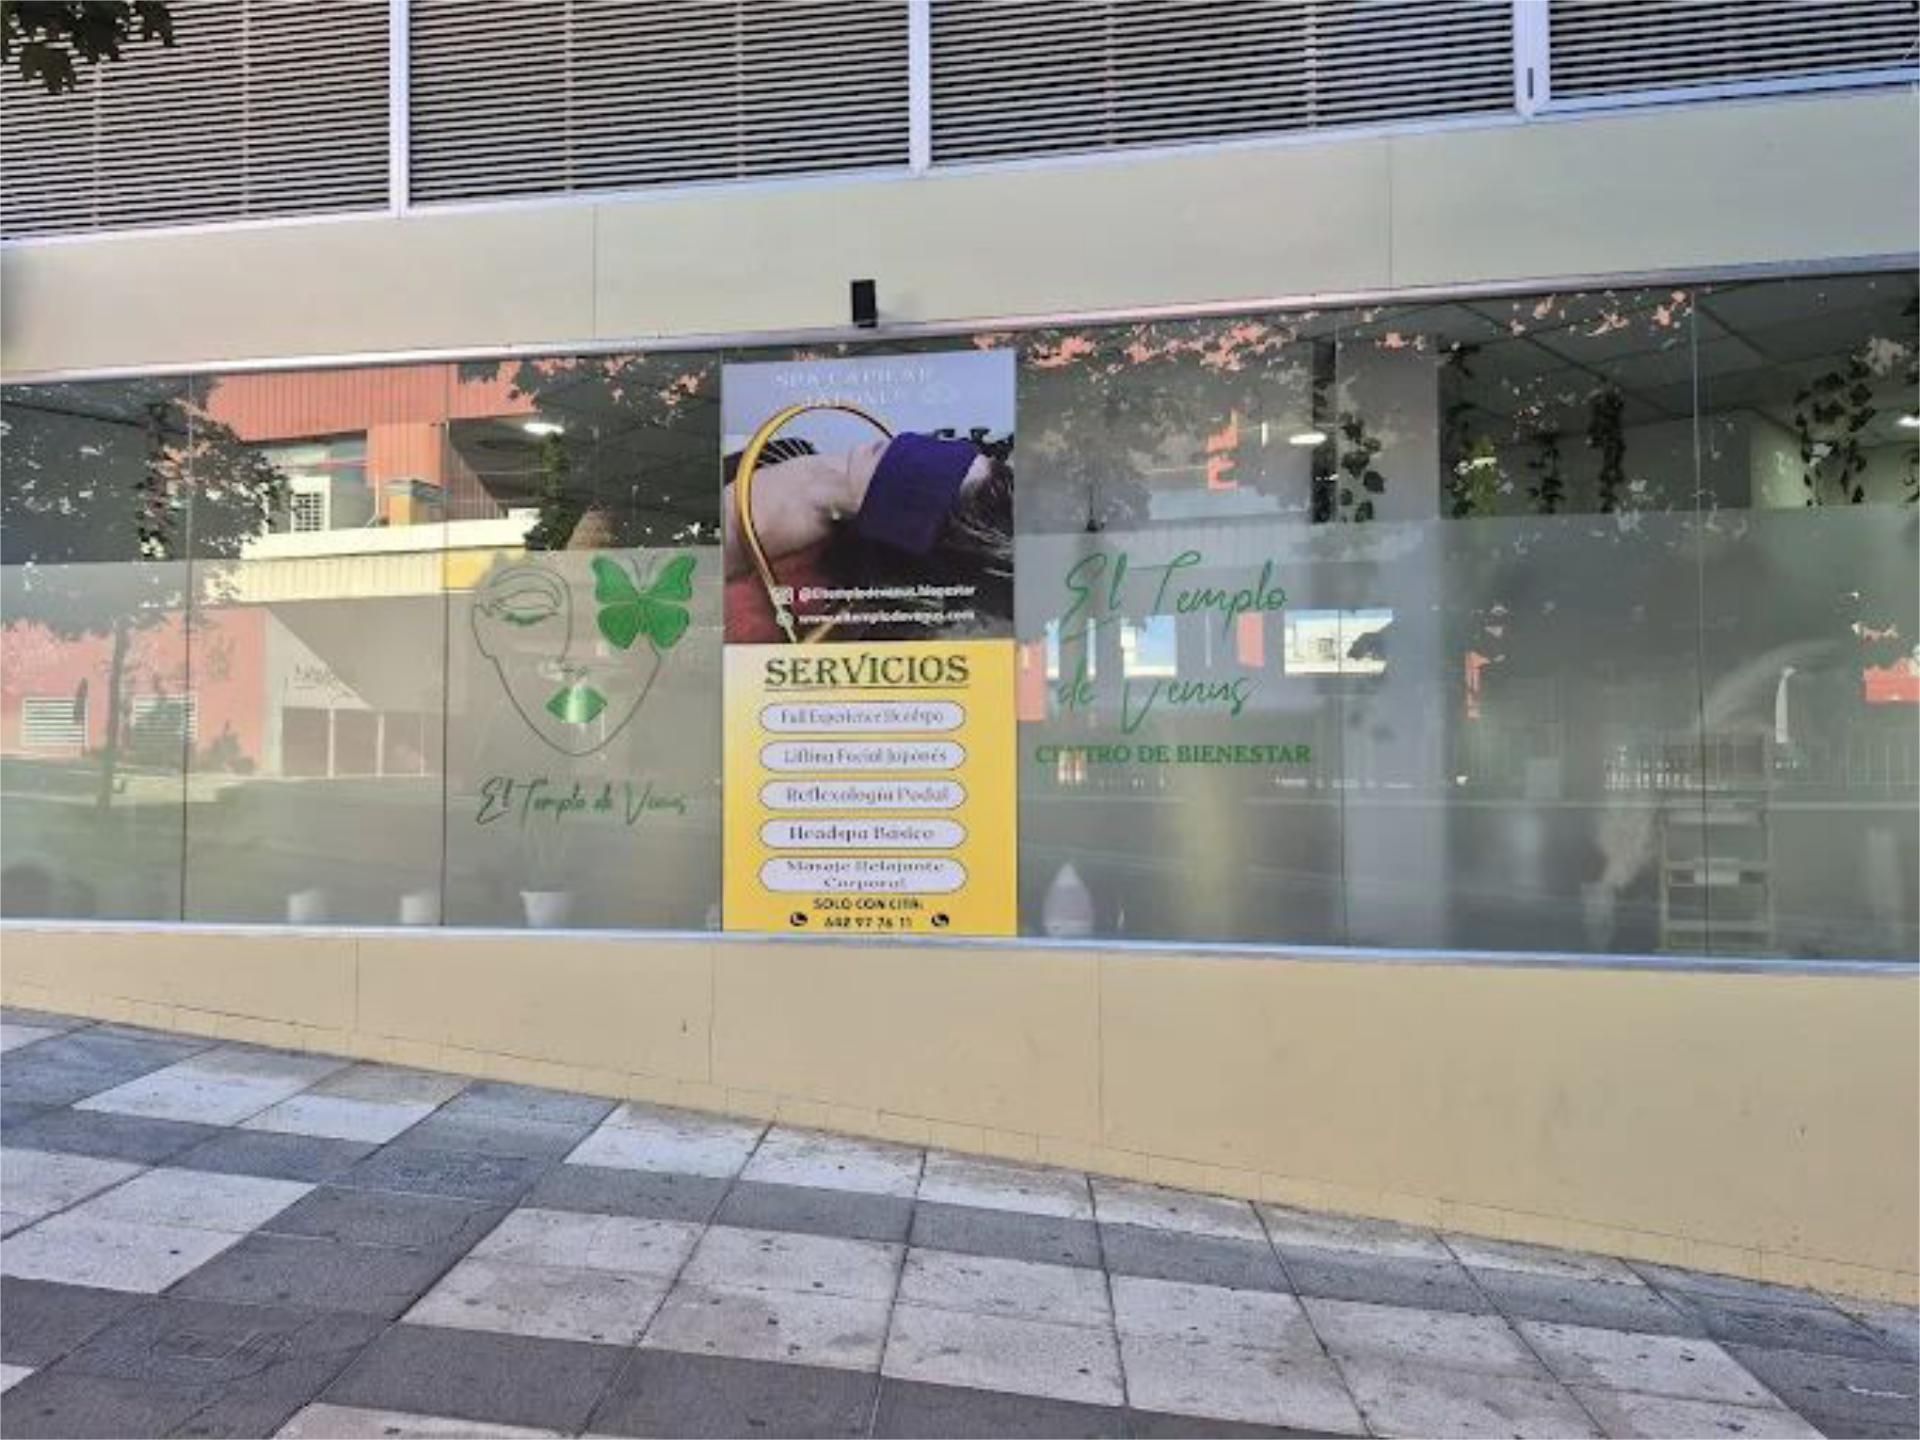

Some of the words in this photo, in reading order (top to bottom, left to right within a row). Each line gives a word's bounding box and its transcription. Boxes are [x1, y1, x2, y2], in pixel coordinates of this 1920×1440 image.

[764, 652, 970, 686] SERVICIOS
[1058, 657, 1096, 713] de
[781, 709, 808, 725] Full
[810, 708, 882, 727] Experience
[1035, 745, 1131, 764] CENTRO
[1137, 745, 1169, 763] DE
[1177, 744, 1312, 763] BIENESTAR
[476, 776, 514, 826] El
[516, 777, 587, 827] Templo
[594, 781, 612, 813] de
[789, 825, 869, 844] Headspa
[787, 860, 851, 875] Masaje
[855, 859, 945, 875] Relajante
[823, 877, 907, 891] Corporal
[813, 897, 853, 911] SOLO
[855, 897, 885, 911] CON
